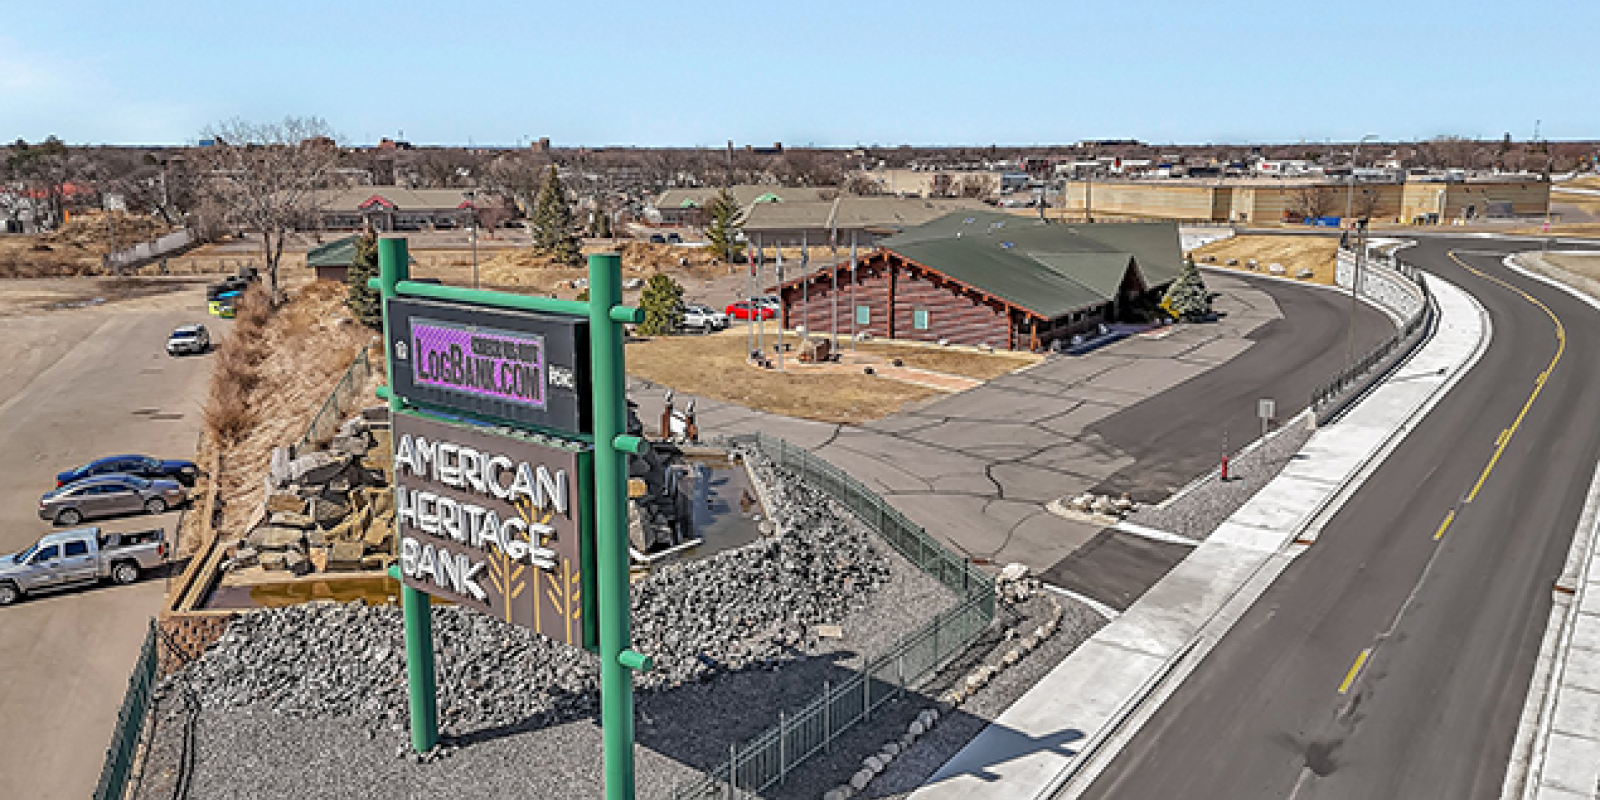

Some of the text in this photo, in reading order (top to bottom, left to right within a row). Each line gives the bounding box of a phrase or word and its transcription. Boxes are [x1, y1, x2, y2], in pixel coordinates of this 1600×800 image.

[395, 434, 568, 514] AMERICAN
[397, 486, 557, 569] HERITAGE
[402, 537, 488, 600] BANK
